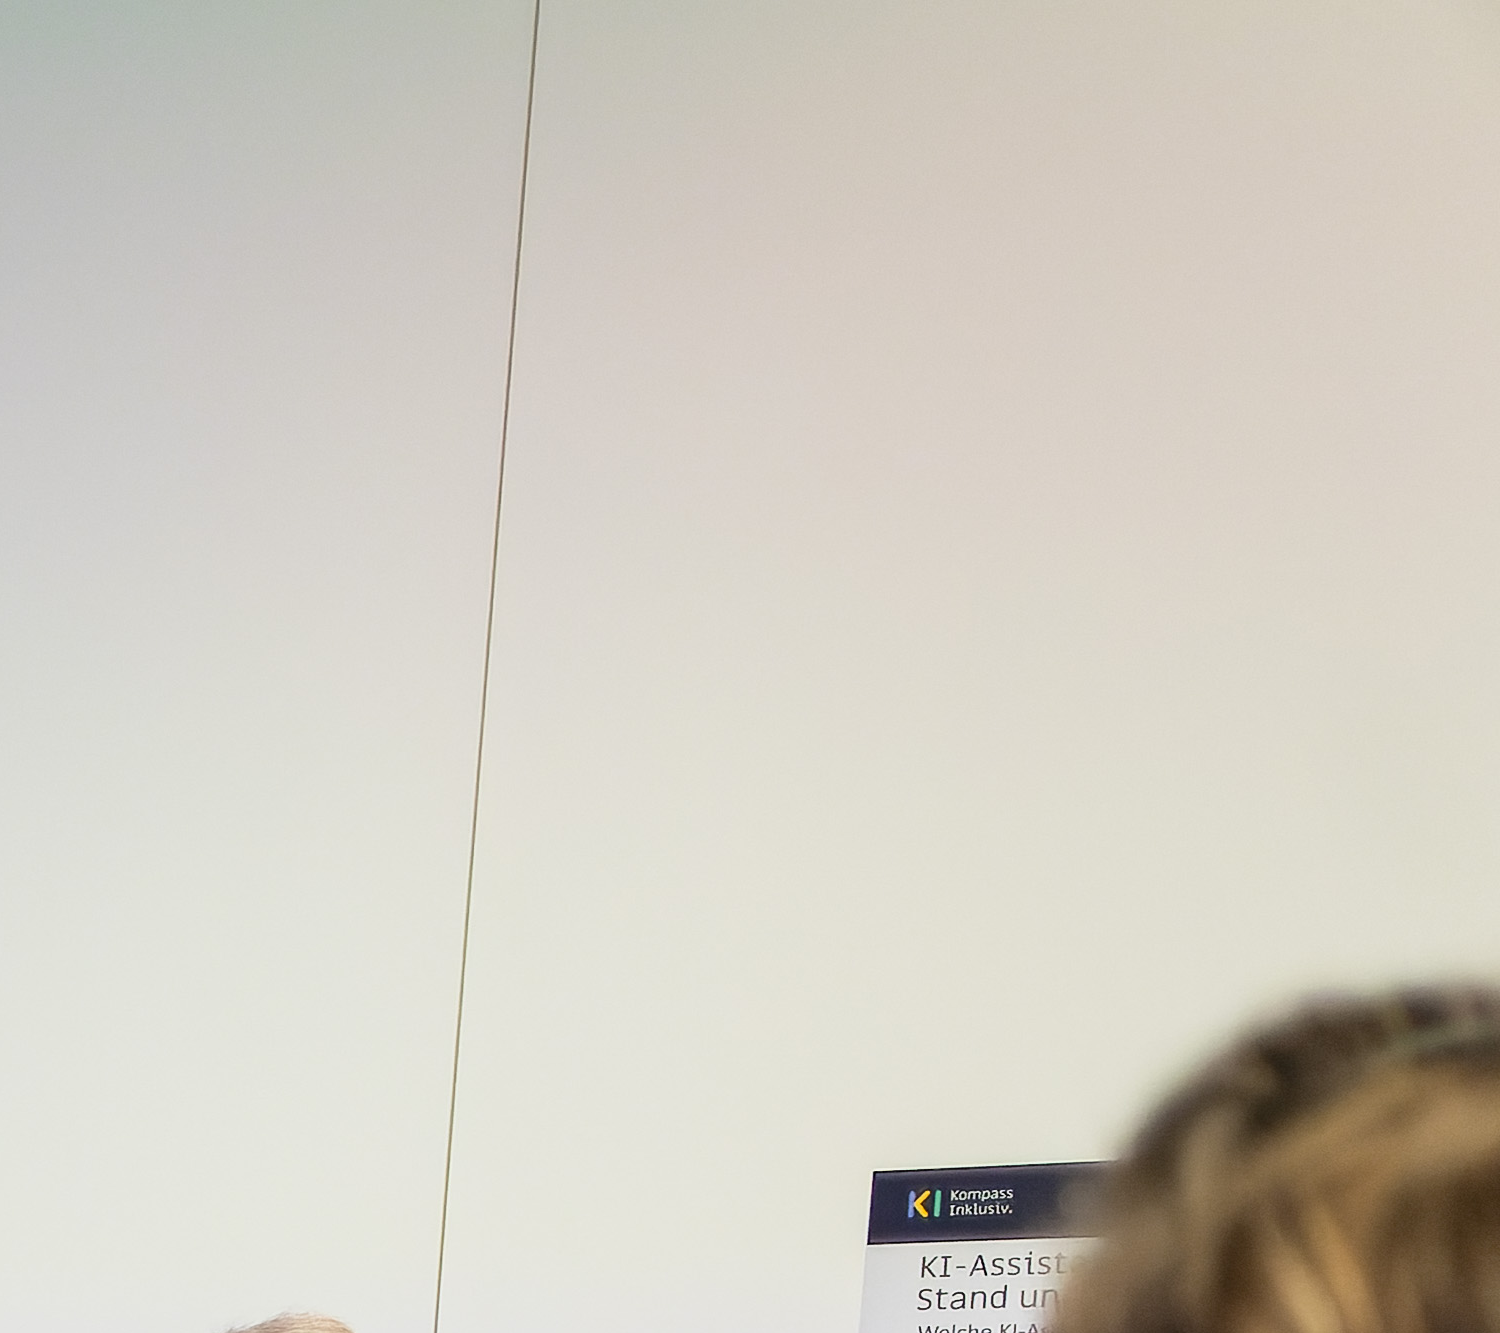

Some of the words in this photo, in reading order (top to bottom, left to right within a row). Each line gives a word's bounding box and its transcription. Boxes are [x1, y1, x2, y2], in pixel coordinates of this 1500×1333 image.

[907, 1189, 942, 1219] KI
[950, 1188, 1014, 1203] Kompass
[949, 1203, 1014, 1217] Inklusiv.
[920, 1250, 1069, 1279] KI-Assist
[916, 1284, 1008, 1311] Stand
